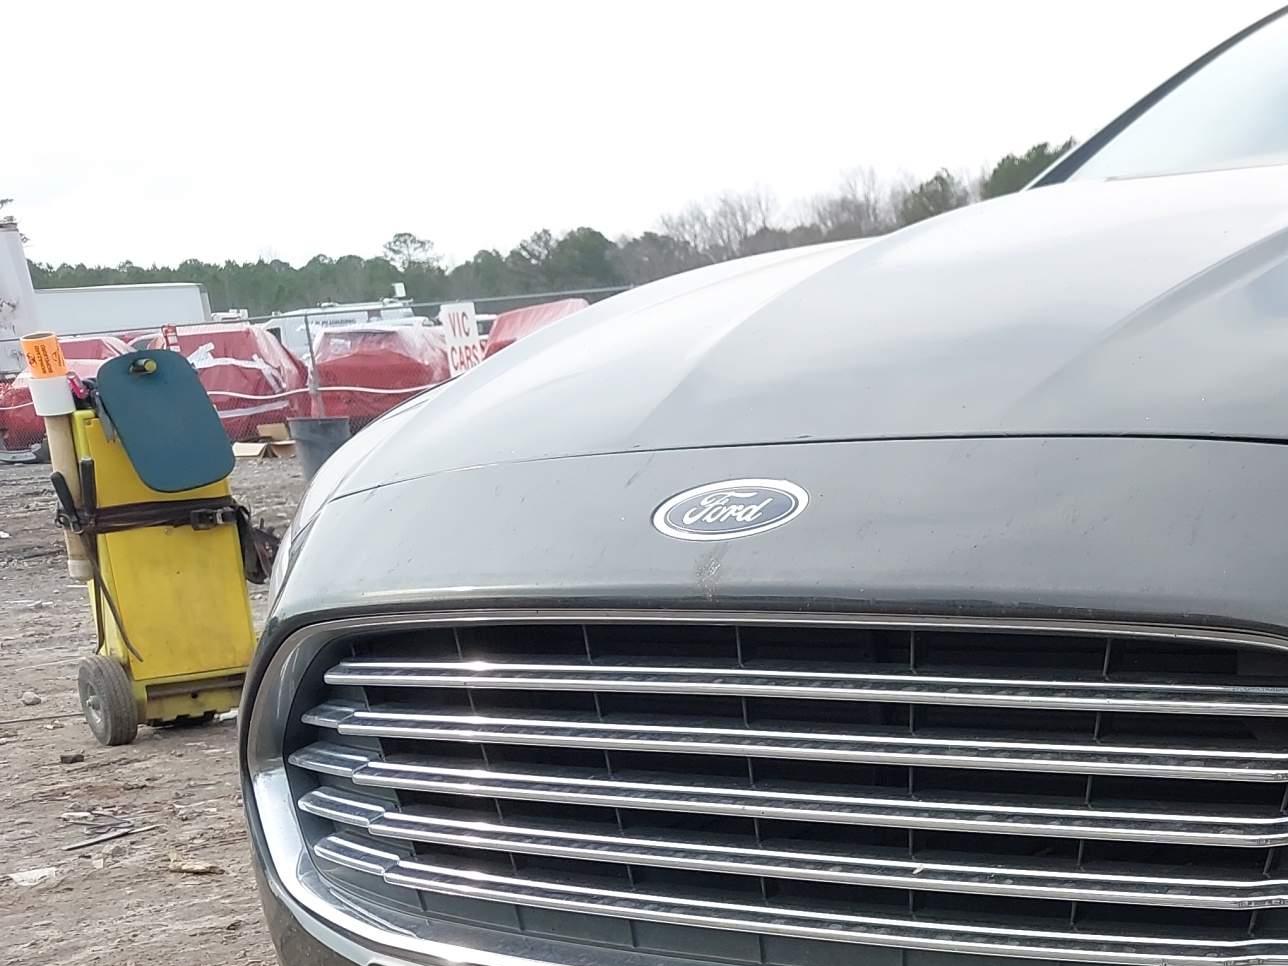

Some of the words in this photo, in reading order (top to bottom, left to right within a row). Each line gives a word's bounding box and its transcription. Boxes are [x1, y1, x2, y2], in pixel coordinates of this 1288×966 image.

[448, 311, 471, 337] VIC
[450, 344, 480, 371] CARS
[682, 491, 774, 525] Ford
